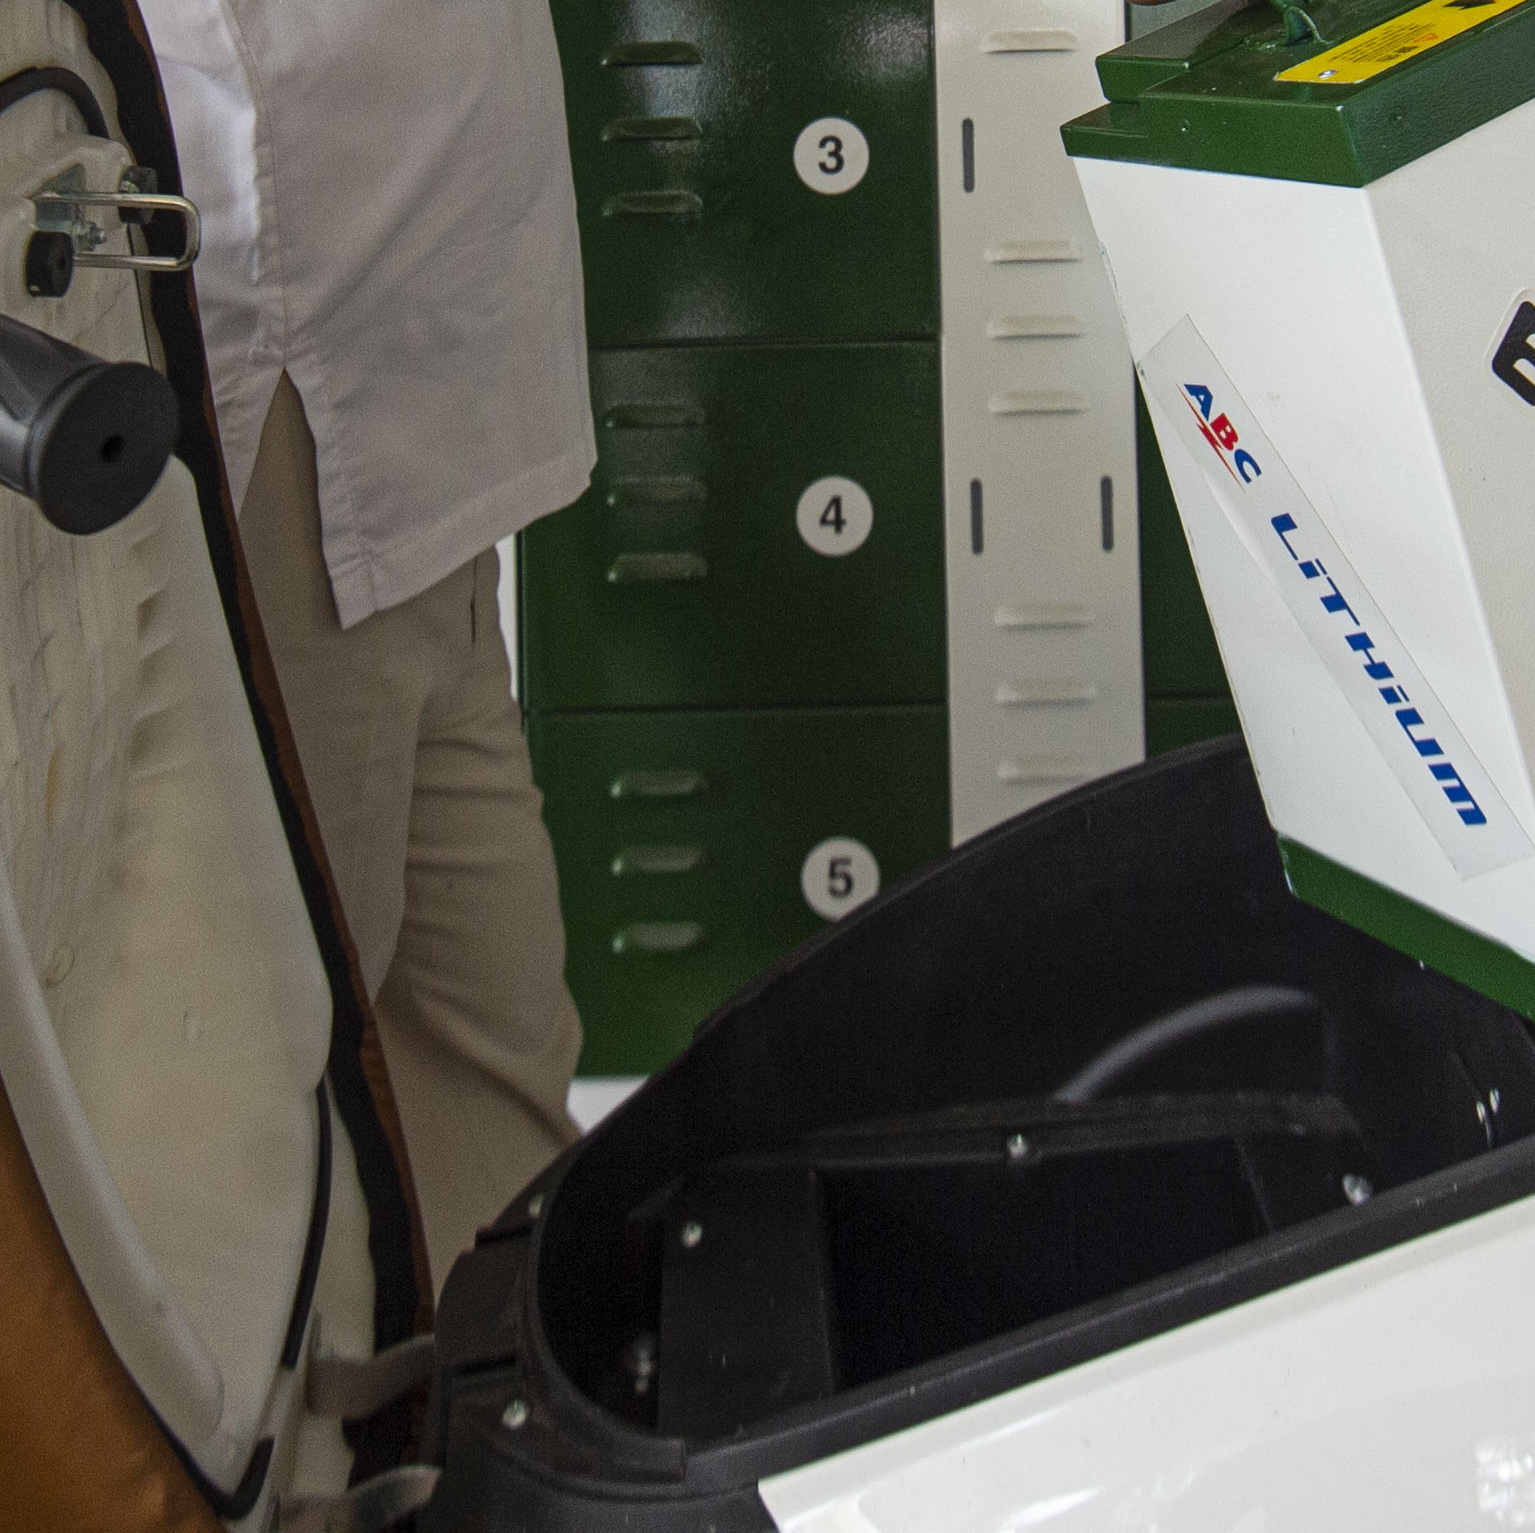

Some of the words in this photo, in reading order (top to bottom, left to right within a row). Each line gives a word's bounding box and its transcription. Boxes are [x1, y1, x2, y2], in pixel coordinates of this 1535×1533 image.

[819, 135, 844, 175] 3
[1184, 383, 1262, 484] ABC
[820, 495, 847, 534] 4
[829, 858, 854, 898] 5
